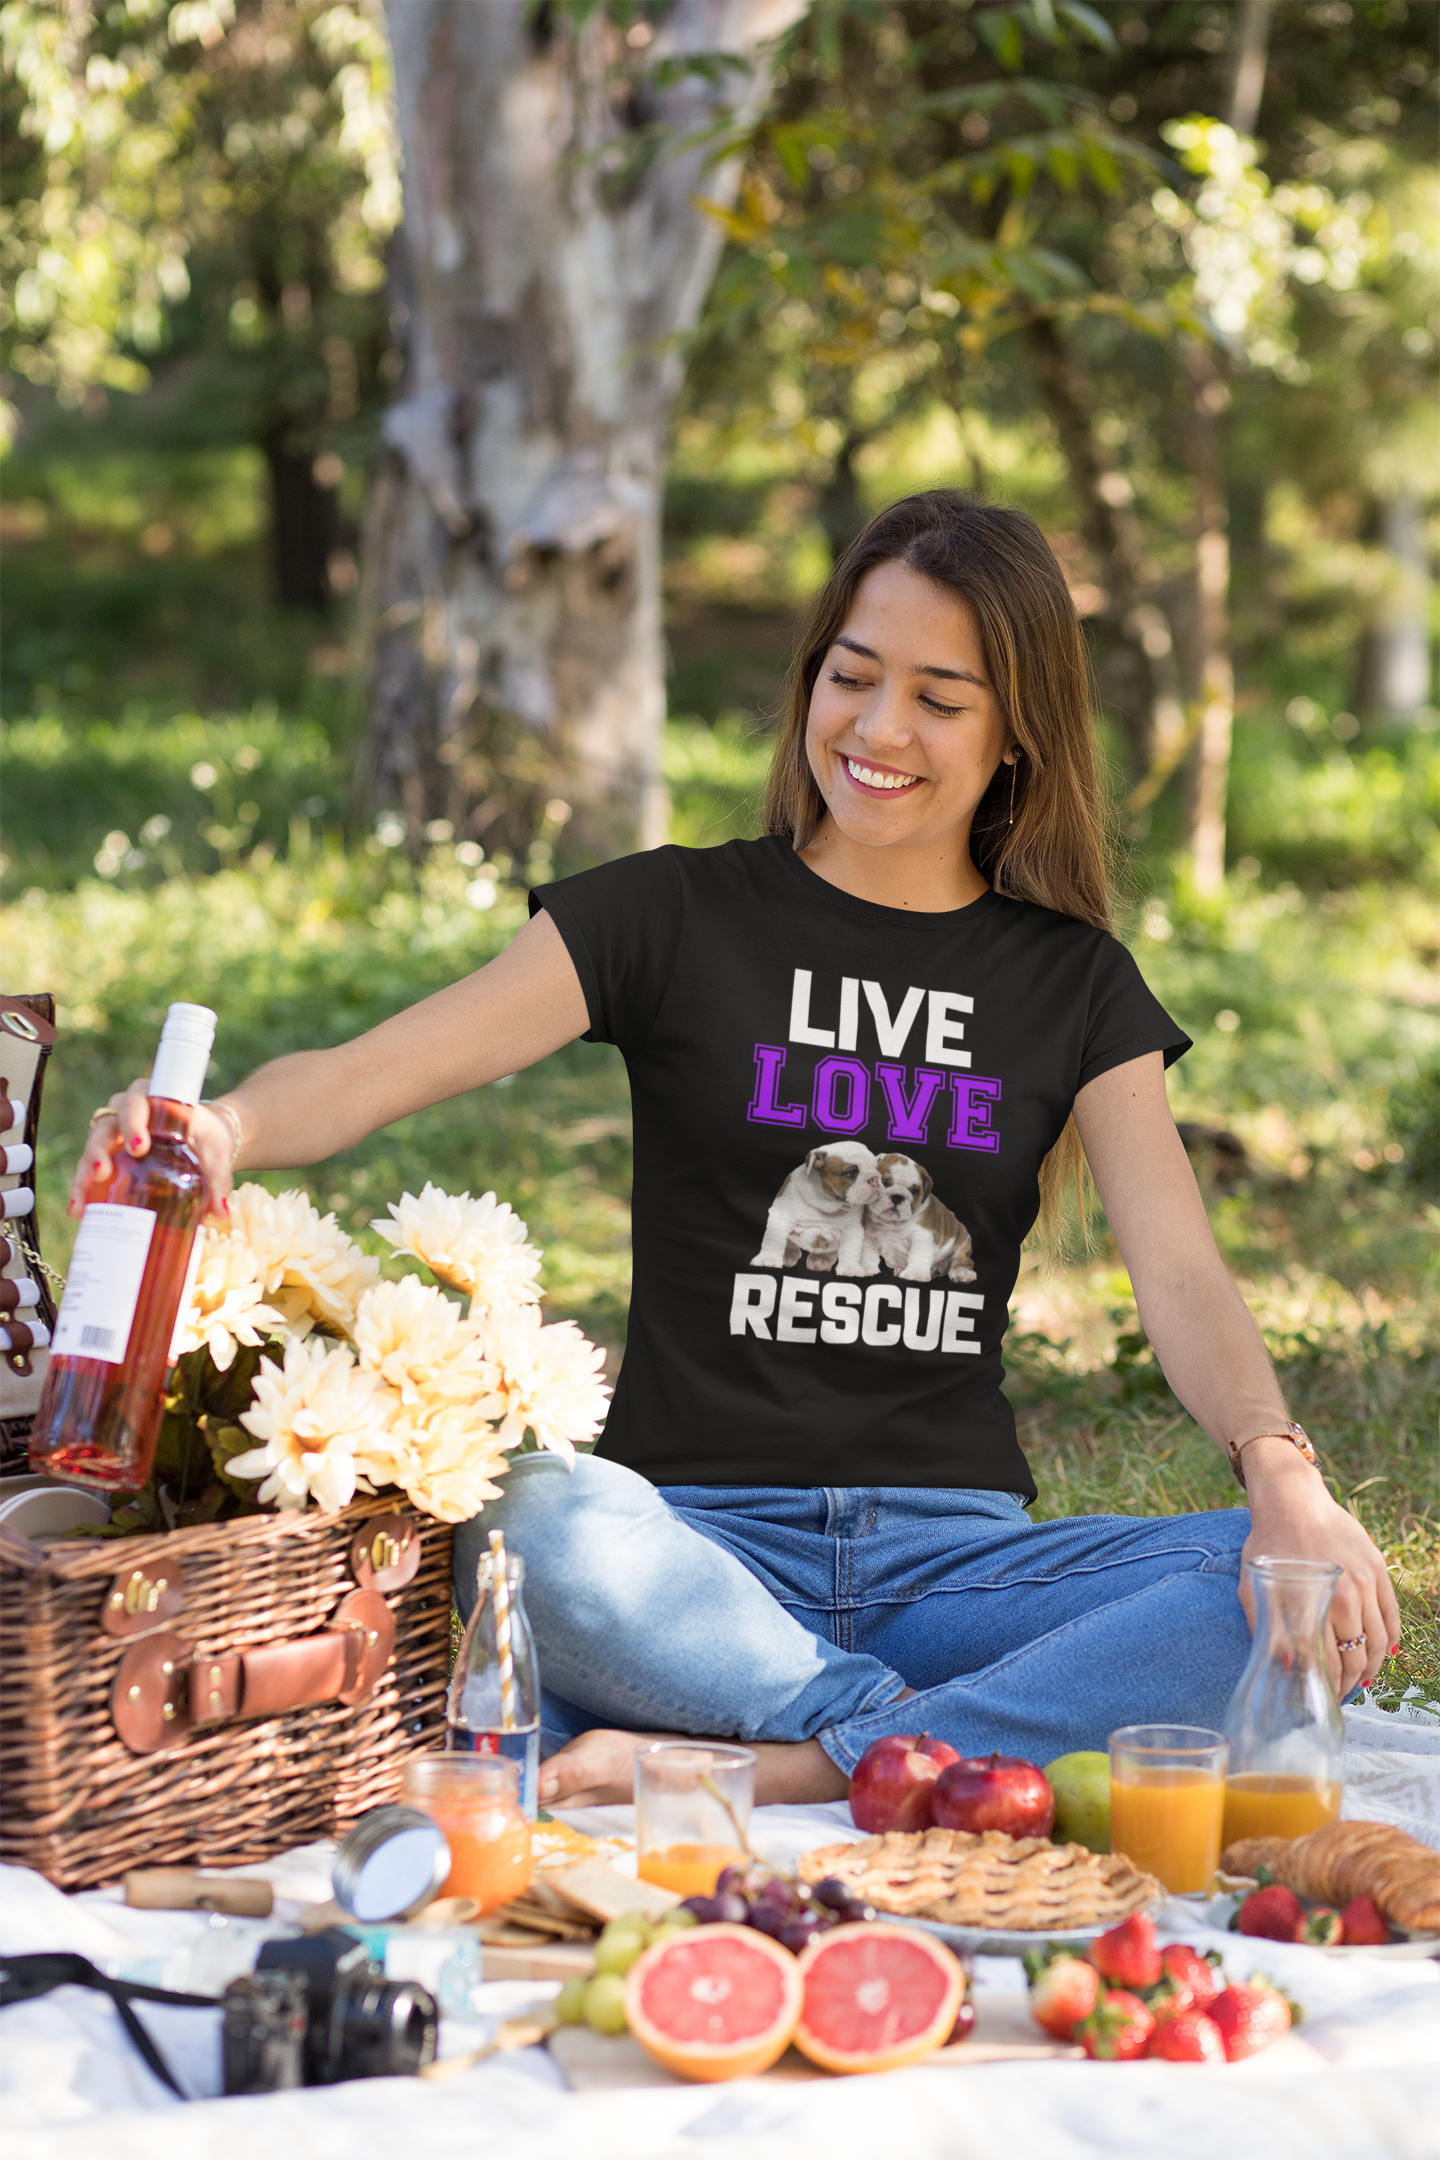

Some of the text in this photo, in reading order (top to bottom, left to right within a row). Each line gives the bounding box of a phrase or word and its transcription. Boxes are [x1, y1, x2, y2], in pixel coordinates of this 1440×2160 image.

[789, 969, 974, 1068] LIVE
[747, 1043, 1002, 1153] LOVE
[730, 1273, 985, 1354] RESCUE
